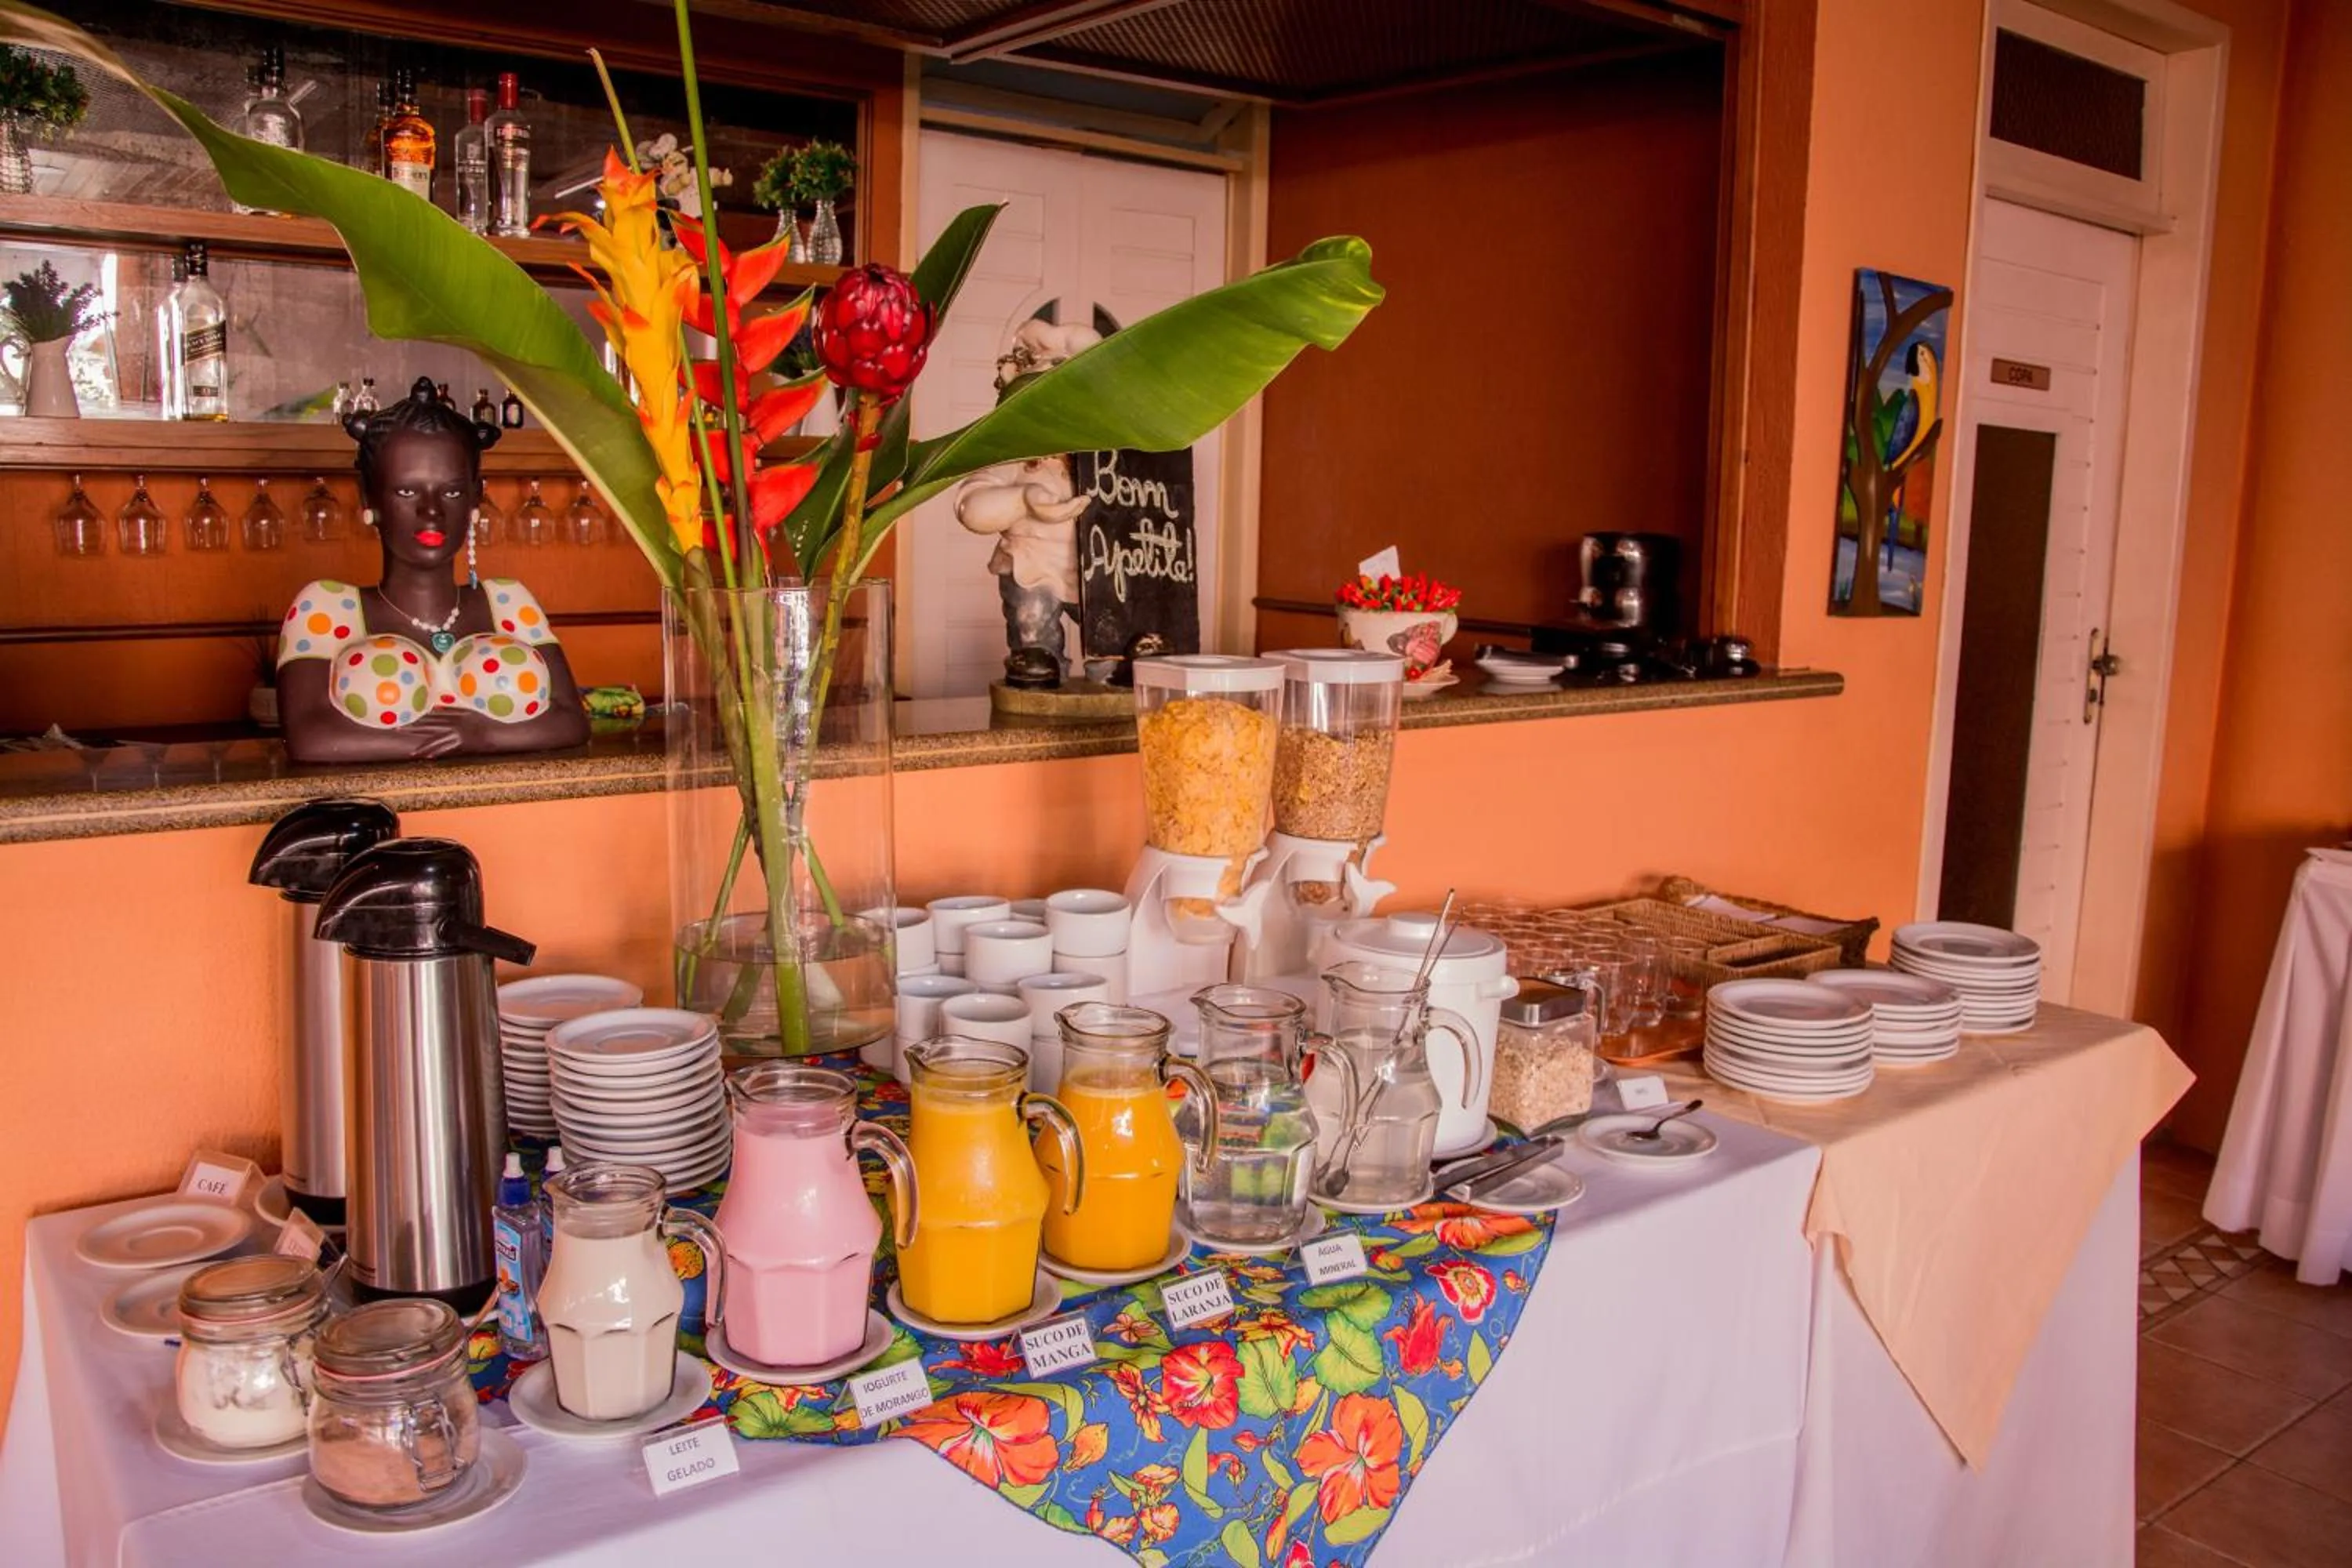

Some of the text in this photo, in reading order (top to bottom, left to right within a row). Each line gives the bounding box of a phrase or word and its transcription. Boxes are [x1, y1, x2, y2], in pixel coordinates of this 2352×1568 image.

[1086, 448, 1179, 518] Bom
[1167, 1278, 1221, 1305] SUCO DE
[1171, 1294, 1231, 1323] LARANJA
[1025, 1323, 1086, 1350] SUCO DE
[1032, 1342, 1091, 1370] MANGA
[862, 1370, 908, 1393] IOGURTE
[860, 1388, 929, 1418] DE MORANGO
[669, 1437, 701, 1456] LEITE
[667, 1457, 716, 1482] GELADO
